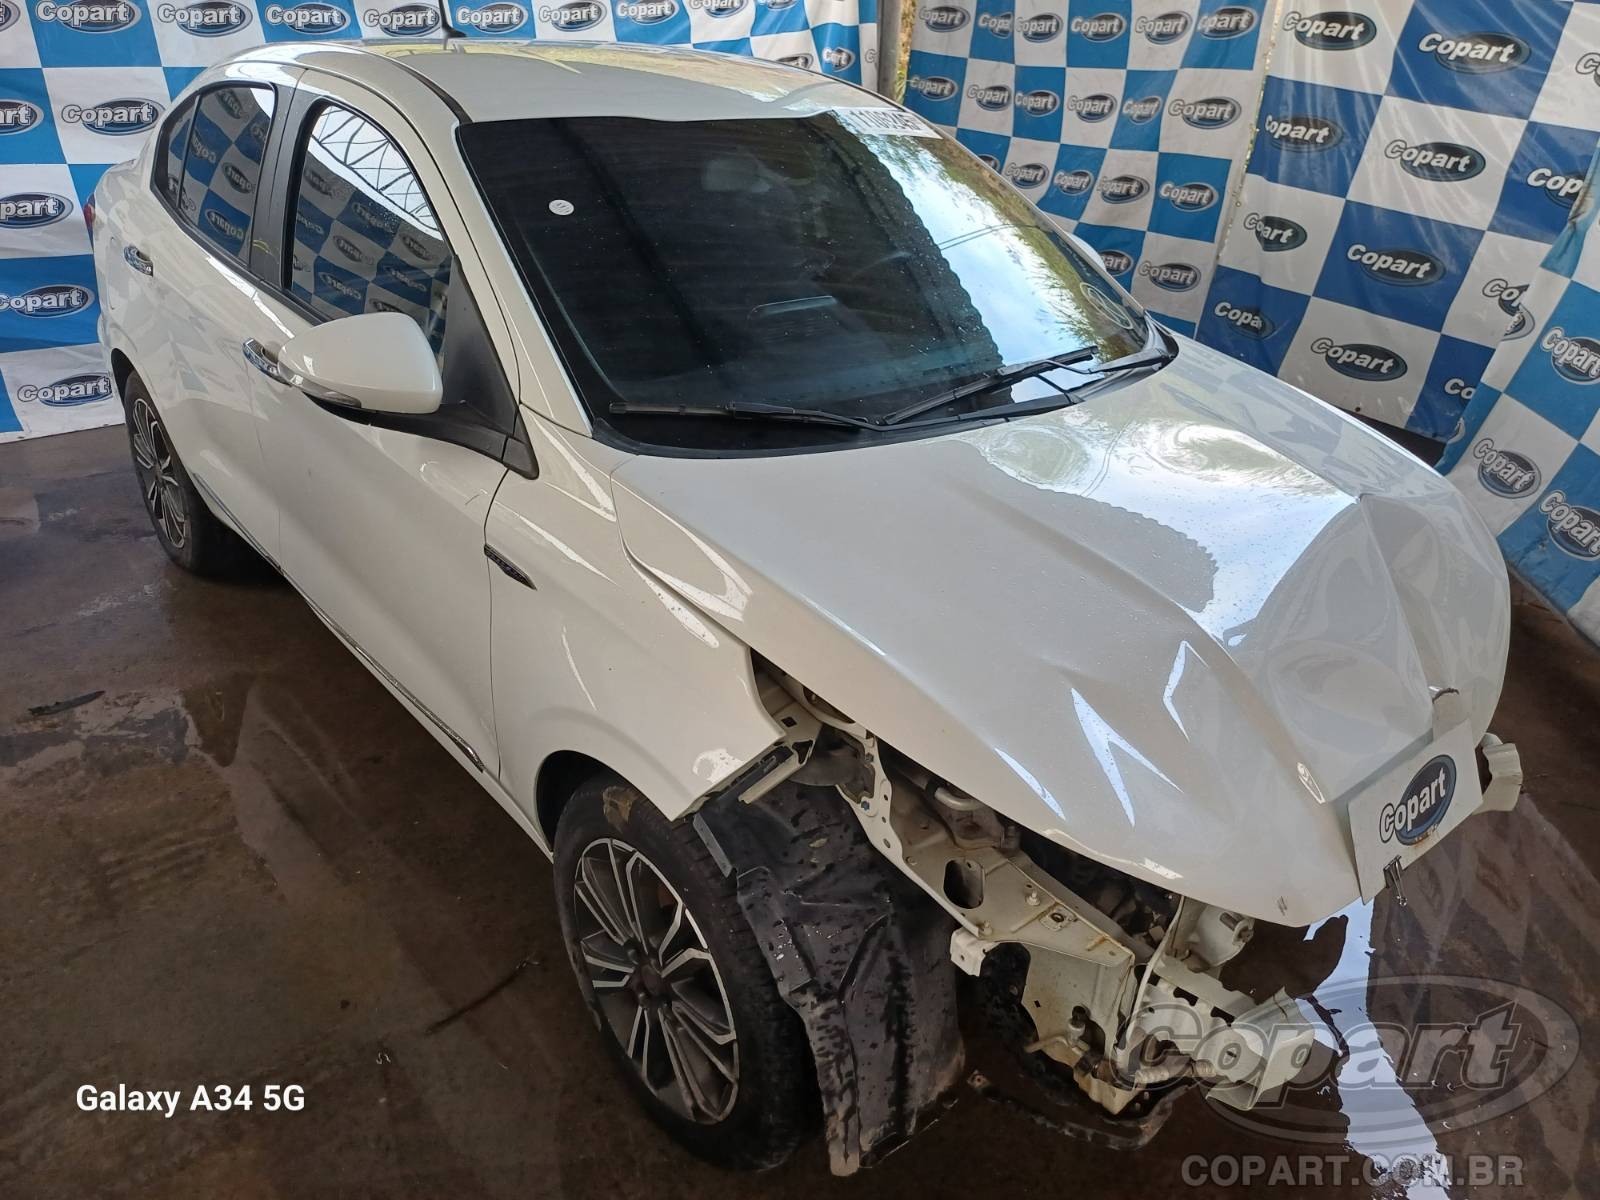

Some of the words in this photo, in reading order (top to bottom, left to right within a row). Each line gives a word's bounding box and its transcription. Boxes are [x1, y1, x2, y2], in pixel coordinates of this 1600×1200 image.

[37, 1, 129, 28] Copart
[158, 4, 241, 29] Copart
[266, 6, 341, 28] Copart
[364, 6, 436, 28] Copart
[457, 6, 521, 27] Copart
[539, 2, 599, 23] Copart
[616, 1, 673, 23] Copart
[920, 6, 963, 26] Copart
[1016, 17, 1058, 36] Copart
[1072, 17, 1120, 37] Copart
[1136, 14, 1186, 37] Copart
[1283, 11, 1365, 41] Copart
[1419, 33, 1516, 64] Copart
[910, 75, 952, 97] Copart
[1015, 92, 1055, 111] Copart
[1069, 95, 1113, 117] Copart
[1168, 98, 1232, 121] Copart
[62, 103, 152, 128] Copart
[1265, 114, 1330, 144] Copart
[1385, 139, 1472, 173] Copart
[1006, 162, 1044, 184] Copart
[1054, 171, 1089, 190] Copart
[1160, 181, 1212, 206] Copart
[1138, 260, 1196, 286] Copart
[1347, 244, 1431, 279] Copart
[1311, 338, 1395, 374] Copart
[17, 374, 111, 403] Copart
[1473, 438, 1535, 491] Copart
[1380, 767, 1446, 844] Copart
